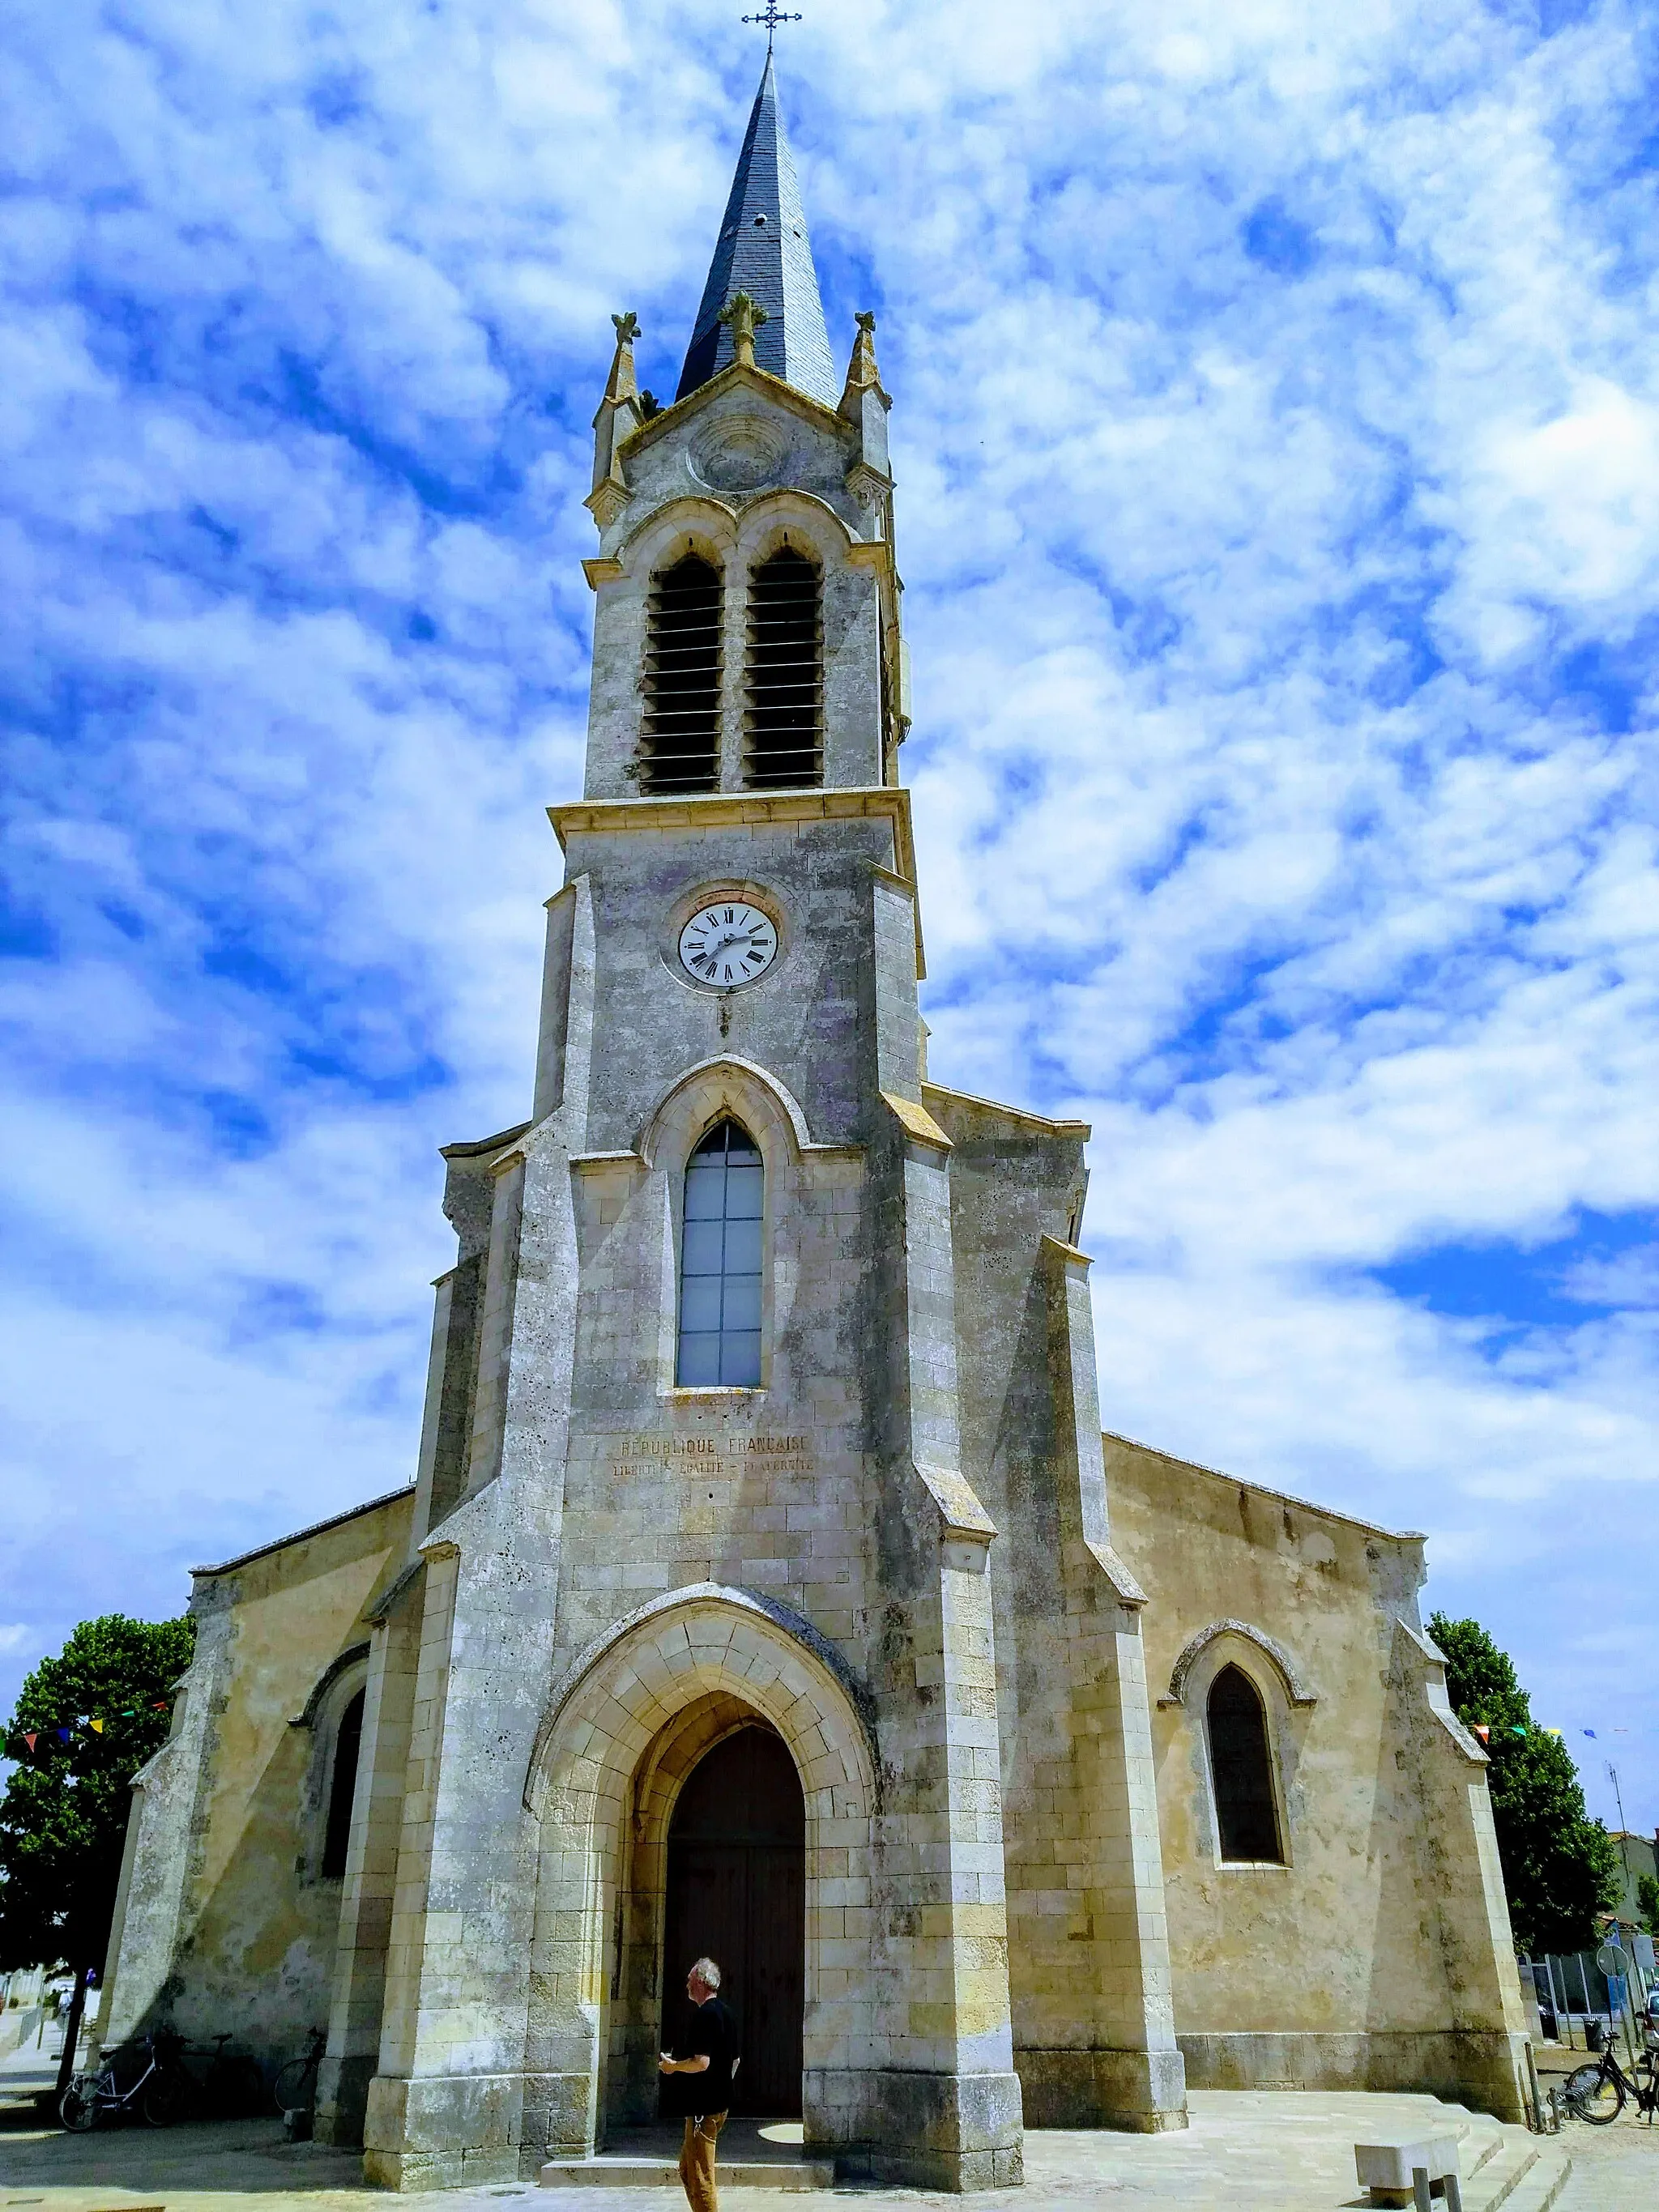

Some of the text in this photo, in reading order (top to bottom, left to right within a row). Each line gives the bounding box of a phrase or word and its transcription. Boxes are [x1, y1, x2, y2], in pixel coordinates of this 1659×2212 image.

[706, 914, 719, 928] XI
[723, 910, 733, 923] XII
[693, 926, 709, 936] X
[748, 923, 764, 935] II
[705, 961, 719, 978] VII
[724, 965, 733, 980] VI
[739, 961, 750, 975] V
